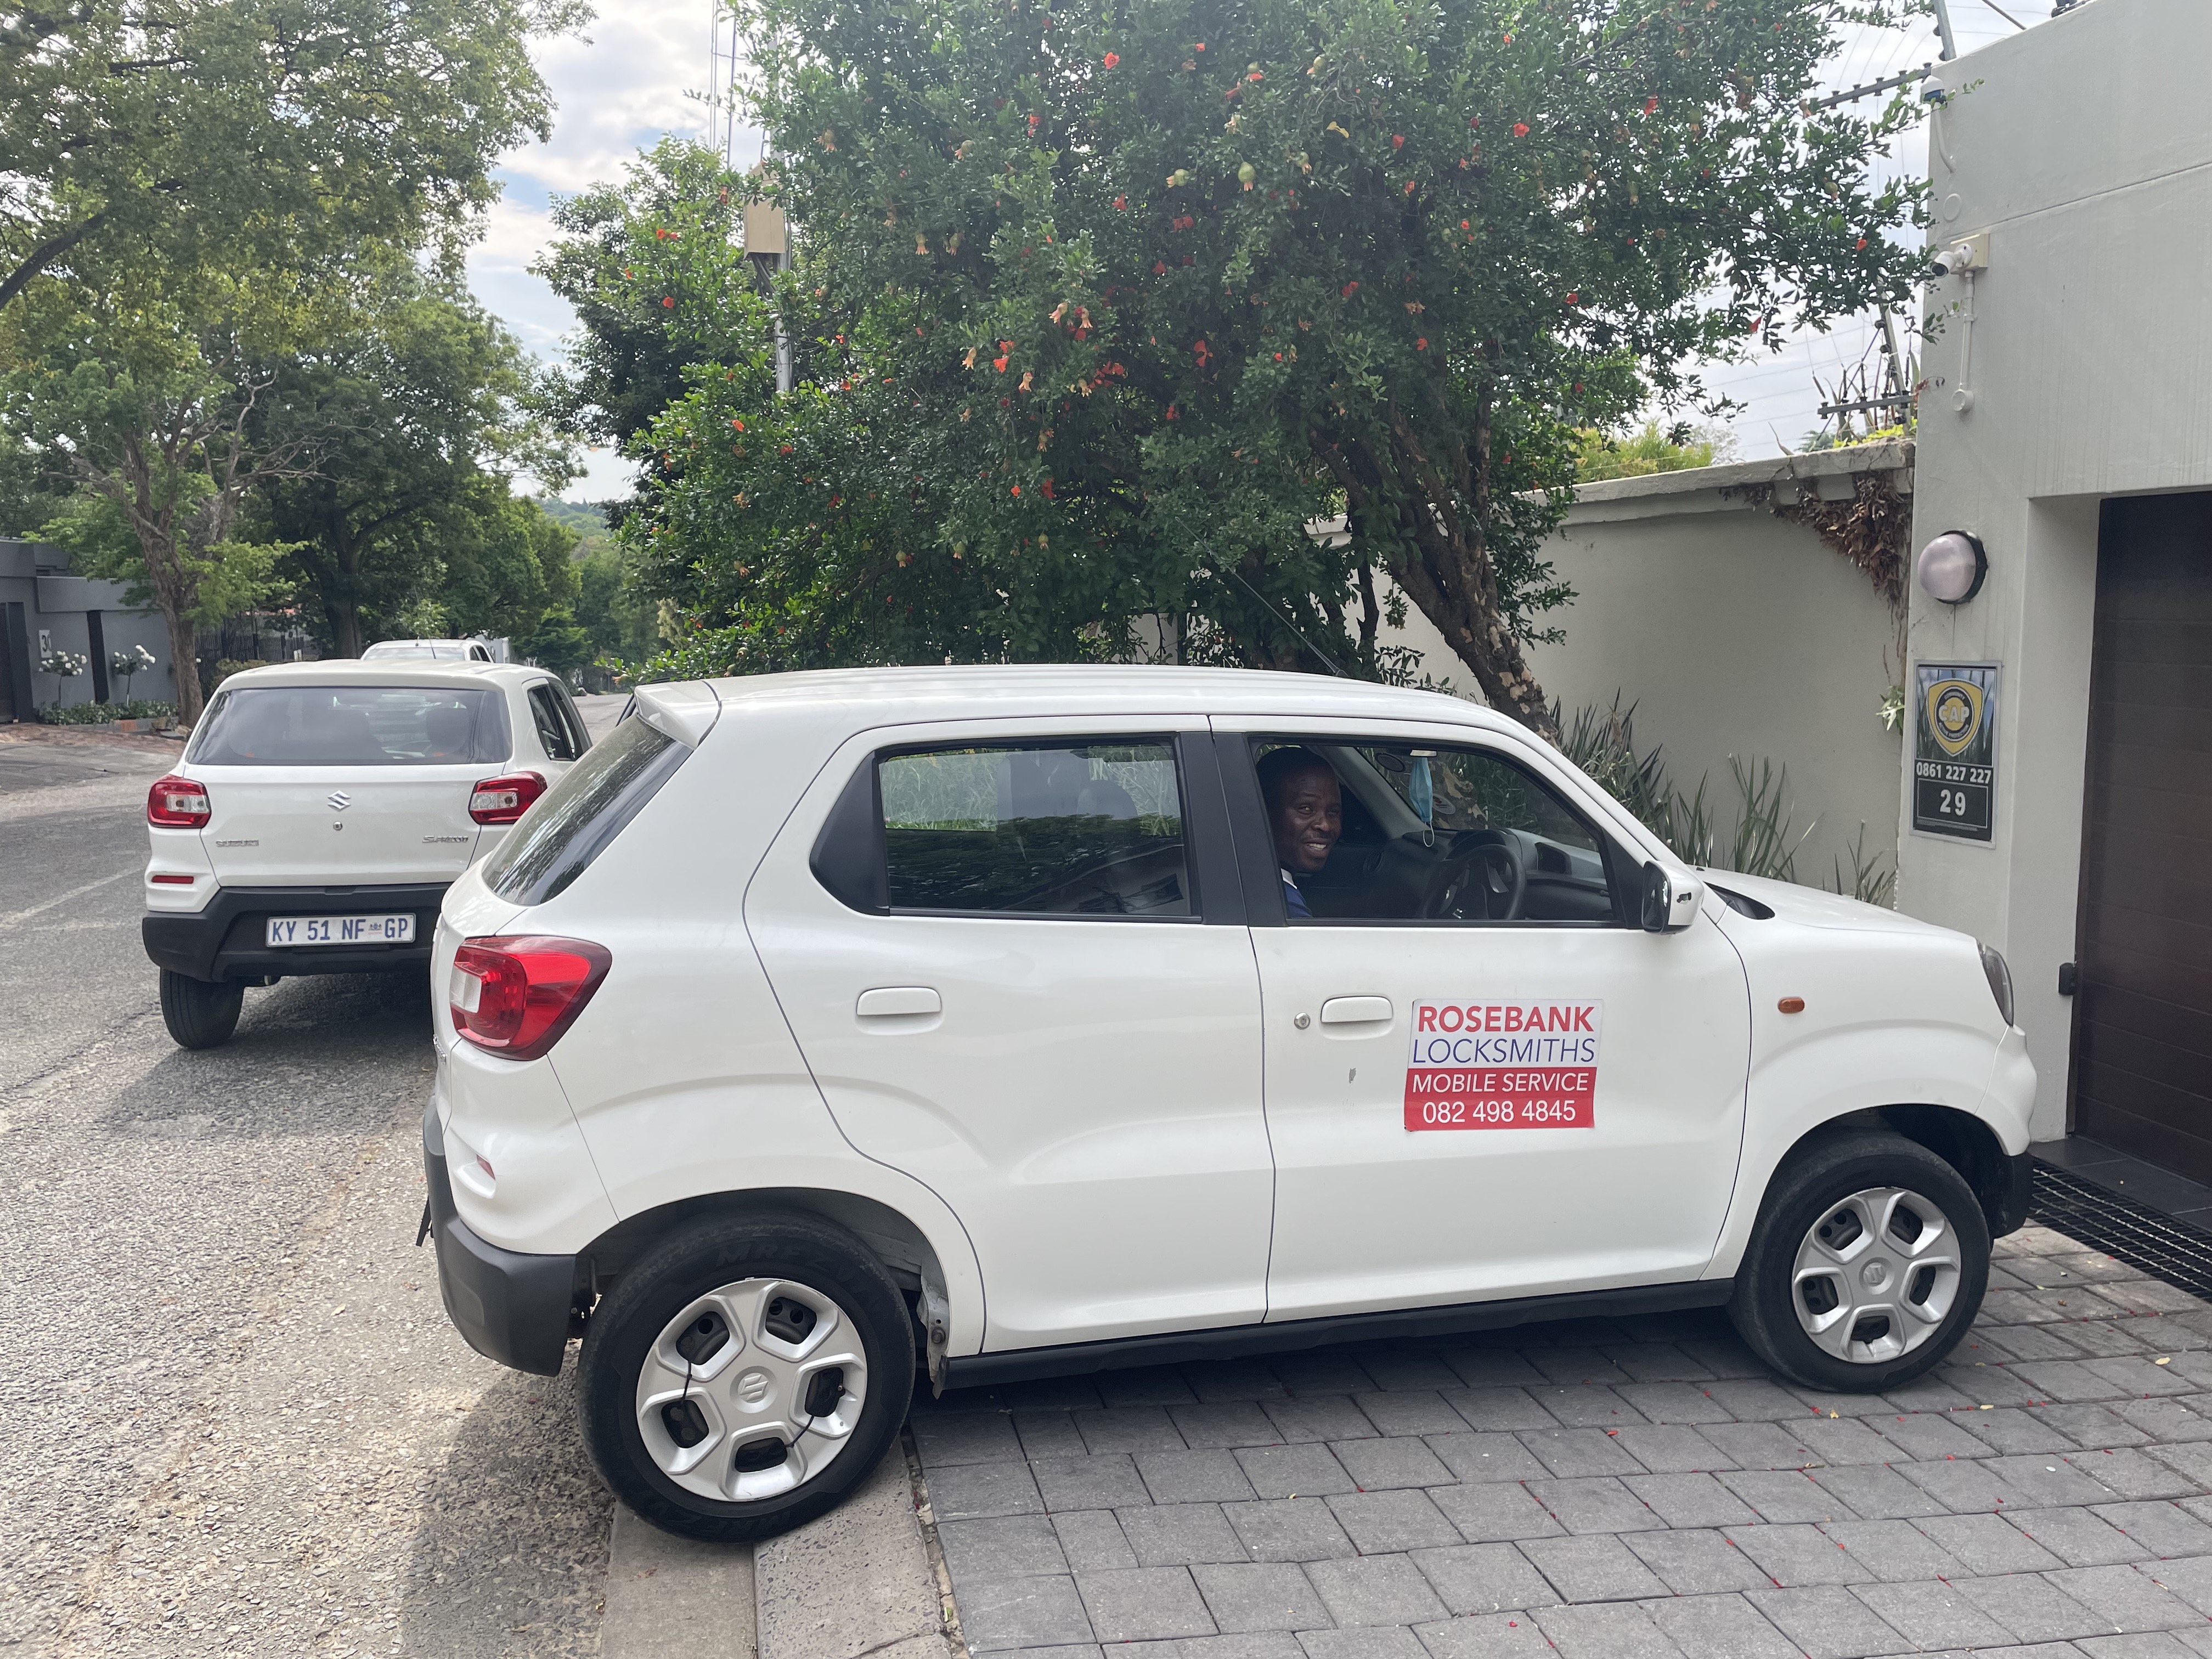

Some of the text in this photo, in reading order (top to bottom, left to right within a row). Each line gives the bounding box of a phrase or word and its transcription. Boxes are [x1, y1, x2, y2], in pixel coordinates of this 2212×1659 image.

[1938, 704, 1970, 723] CAP
[1916, 761, 1991, 784] 0861 227 227
[1940, 789, 1966, 816] 29
[273, 918, 408, 941] KY 51 NF GP
[1418, 1006, 1595, 1032] ROSEBANK
[1413, 1039, 1595, 1063] LOCKSMITHS
[1412, 1073, 1589, 1093] MOBILE SERVICE
[1423, 1099, 1576, 1124] 082 498 4845
